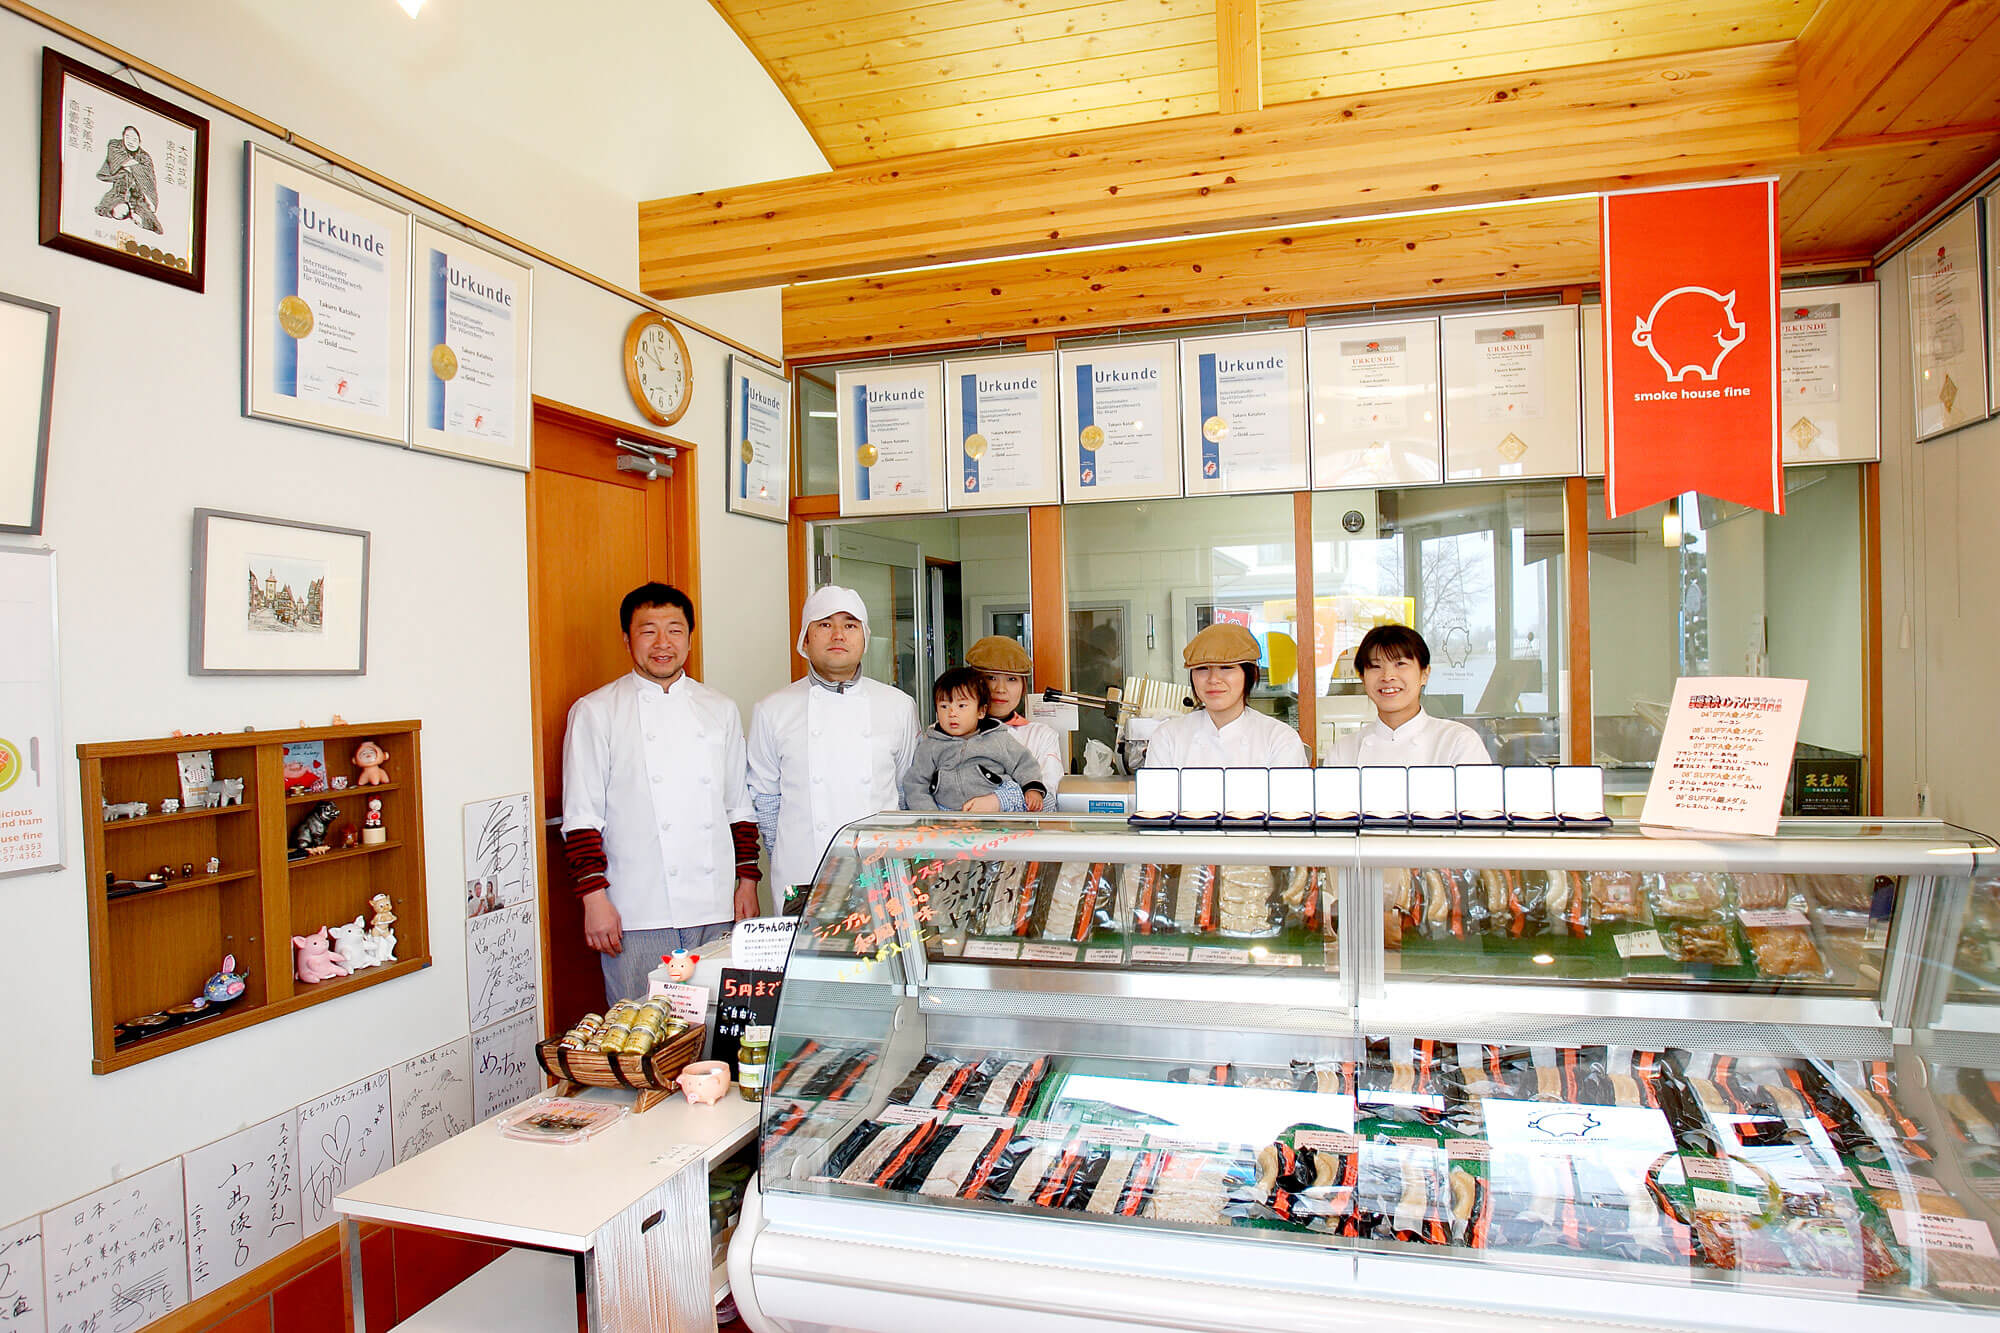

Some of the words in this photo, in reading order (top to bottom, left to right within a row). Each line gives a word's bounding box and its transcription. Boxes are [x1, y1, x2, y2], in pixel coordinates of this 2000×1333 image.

[303, 207, 384, 257] Urkunde
[450, 267, 512, 307] Urkunde
[649, 330, 655, 343] 11
[658, 330, 664, 343] 12
[1488, 343, 1531, 353] URKUNDE
[639, 356, 644, 368] 9
[674, 352, 679, 365] 2
[1219, 356, 1284, 373] Urkunde
[642, 373, 647, 385] 8
[1096, 368, 1158, 383] Urkunde
[980, 377, 1038, 393] Urkunde
[649, 388, 655, 400] 7
[750, 387, 780, 410] Urkunde
[869, 387, 925, 403] Urkunde
[1634, 389, 1678, 402] smoke
[1681, 388, 1721, 400] house
[1724, 386, 1751, 398] fine
[19, 817, 43, 826] ham
[23, 832, 43, 841] fine
[723, 978, 781, 998] 5円まで
[721, 1005, 758, 1020] ご自由に
[479, 1051, 527, 1078] めっちゃ
[73, 1189, 141, 1226] 日本一の
